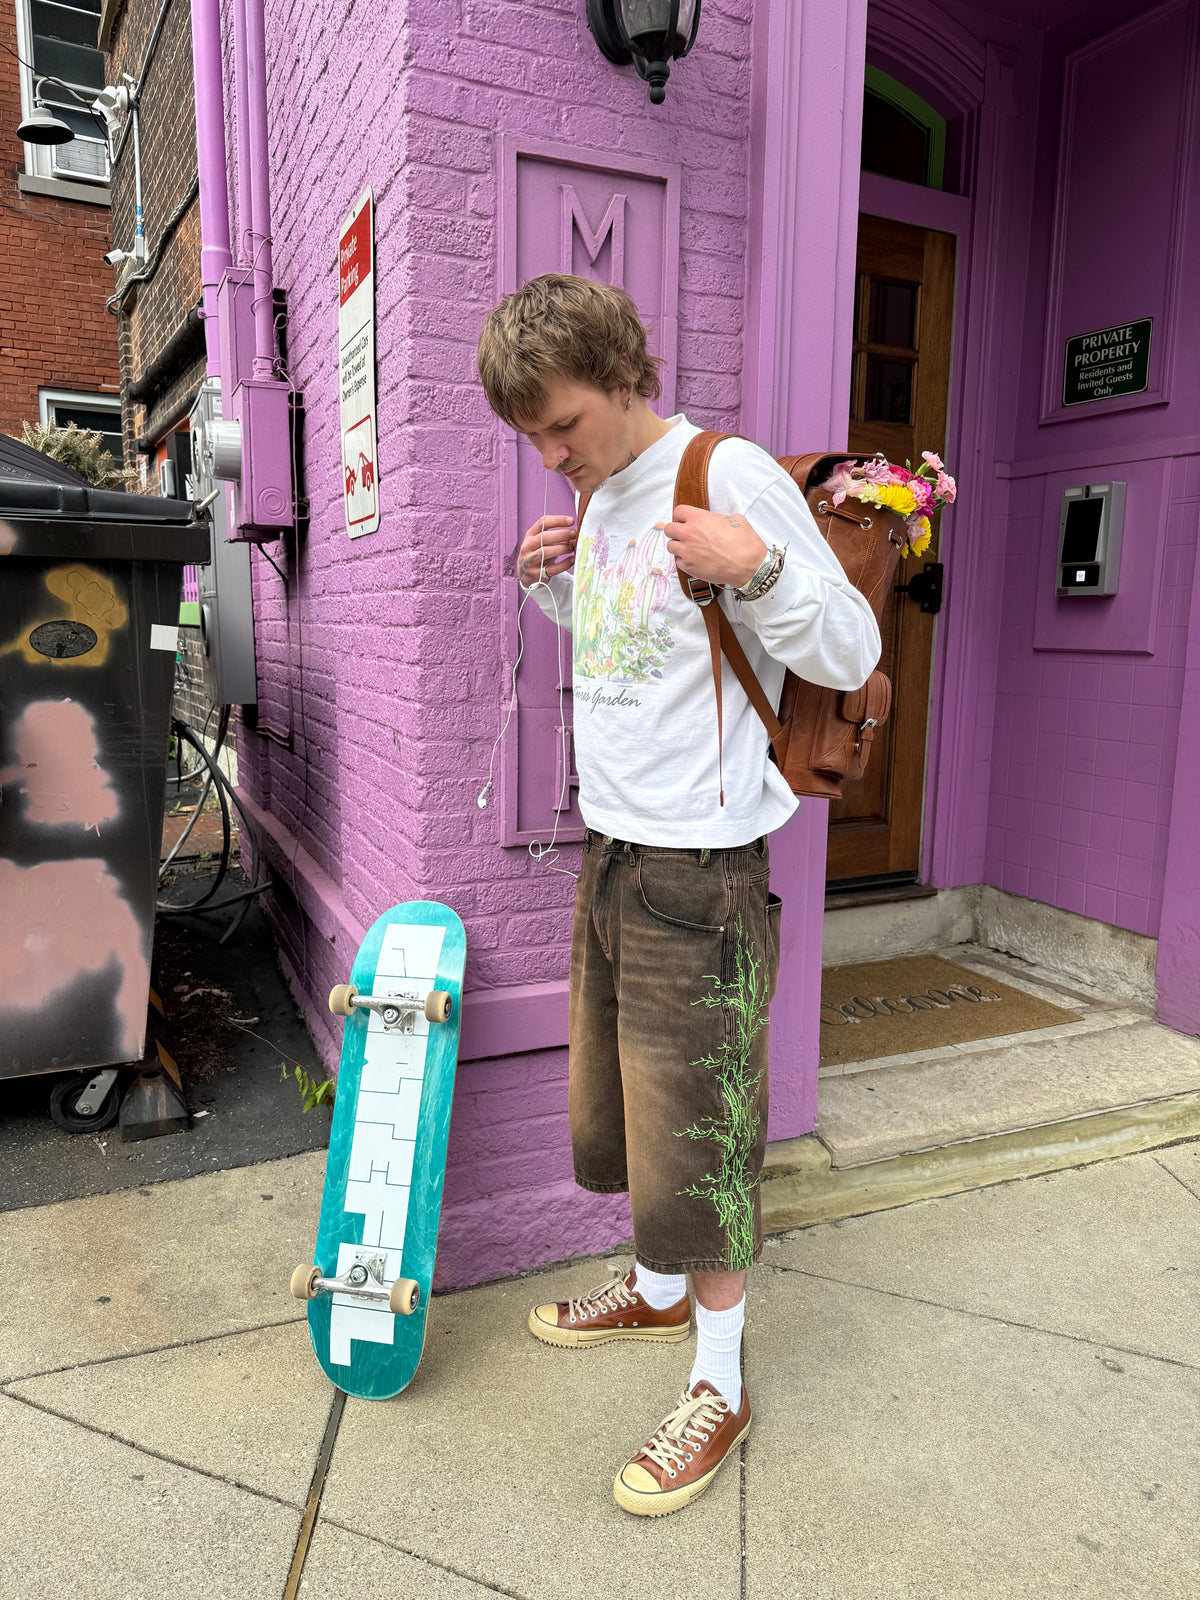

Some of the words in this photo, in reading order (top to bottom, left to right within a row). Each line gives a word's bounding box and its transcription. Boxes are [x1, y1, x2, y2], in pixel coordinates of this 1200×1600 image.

[559, 183, 628, 288] M
[341, 234, 357, 269] Private
[341, 262, 359, 297] Parking
[361, 335, 369, 350] Cars
[1082, 326, 1133, 350] PRIVATE
[1074, 340, 1141, 367] PROPERTY
[352, 355, 361, 376] Towed
[1079, 366, 1115, 380] Residents
[1117, 360, 1133, 372] and
[354, 374, 367, 395] Expense
[1077, 376, 1104, 391] Invited
[1105, 372, 1133, 385] Guests
[1093, 385, 1114, 397] Only
[591, 686, 641, 714] Garden
